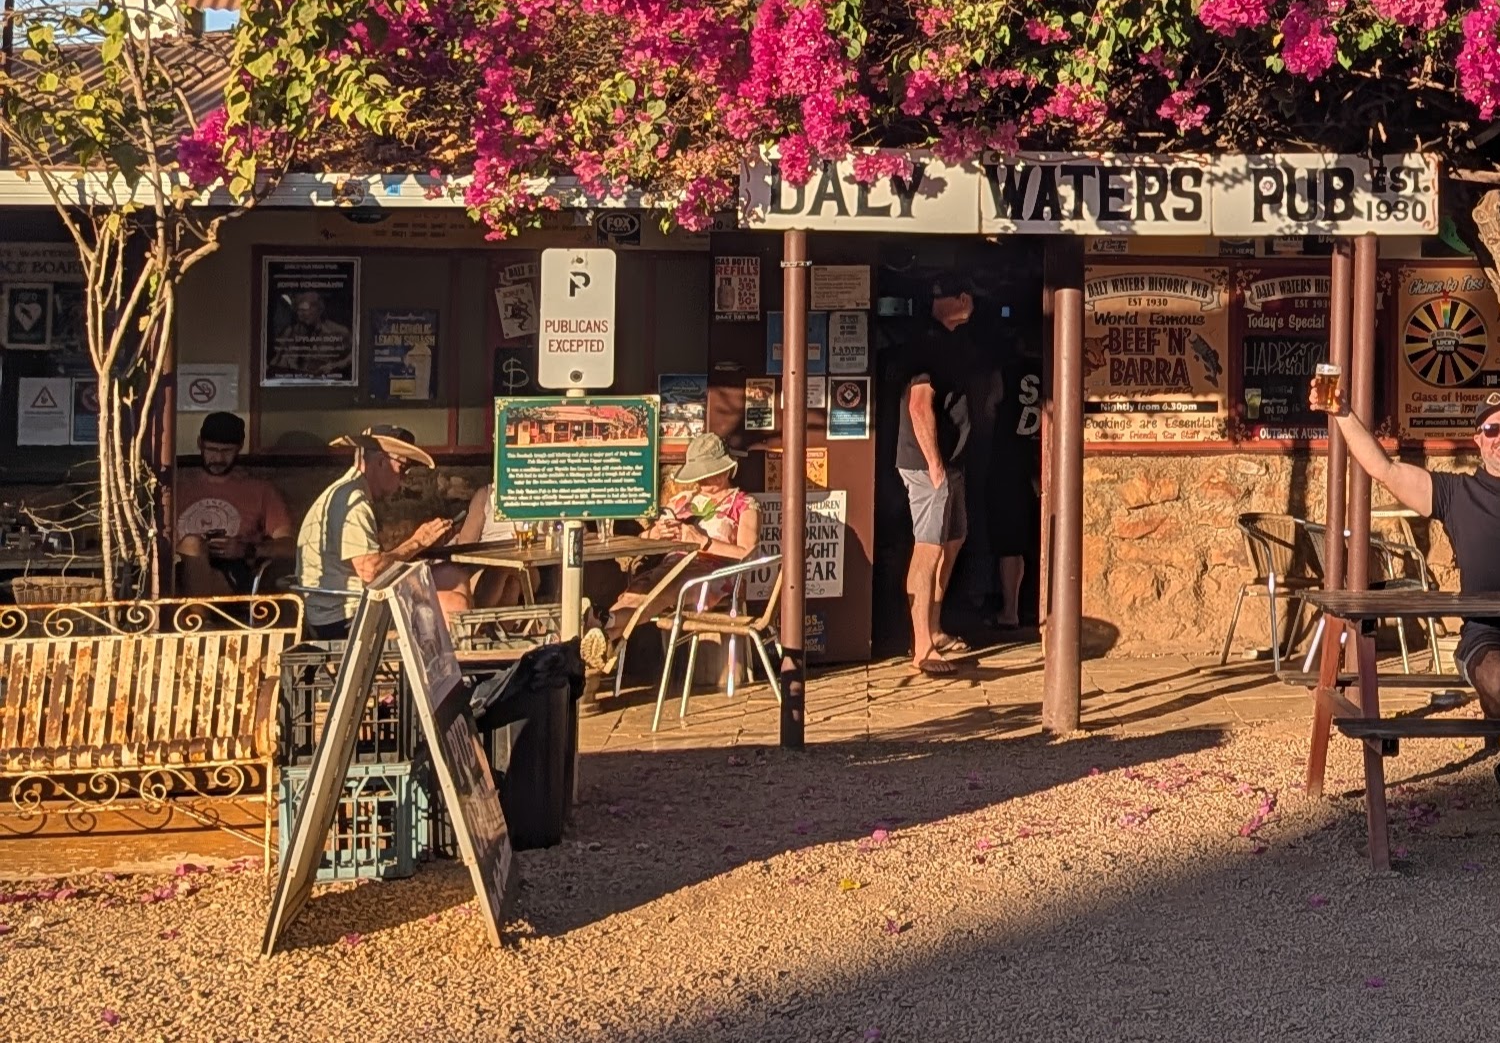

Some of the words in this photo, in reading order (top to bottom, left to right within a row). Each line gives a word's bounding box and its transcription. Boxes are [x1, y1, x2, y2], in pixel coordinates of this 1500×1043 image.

[1371, 166, 1431, 194] EST.
[768, 158, 926, 219] DALY
[984, 164, 1204, 222] WATERS
[1252, 166, 1355, 222] PUB
[1366, 200, 1427, 223] 1930
[715, 266, 759, 275] REFILLS
[1087, 280, 1109, 298] DALY
[1112, 277, 1145, 293] WATERS
[1149, 276, 1188, 293] HISTORIC
[1190, 284, 1209, 299] PUB
[1255, 282, 1276, 299] DALY
[1279, 279, 1312, 295] WATERS
[1408, 278, 1442, 296] Chance
[1460, 274, 1487, 293] Toss
[1128, 298, 1142, 307] EST
[1146, 298, 1168, 307] 1930
[1094, 311, 1139, 326] World
[1149, 312, 1206, 326] Famous
[1247, 313, 1285, 332] Today's
[1288, 313, 1326, 332] Special
[545, 319, 609, 334] PUBLICANS
[548, 339, 605, 353] EXCEPTED
[1108, 327, 1161, 356] BEEF
[1109, 357, 1191, 387] BARRA
[1411, 391, 1438, 402] Glass
[1441, 391, 1451, 402] of
[1455, 391, 1486, 402] House
[1100, 402, 1135, 413] Nightly
[1137, 403, 1160, 411] from
[1405, 403, 1423, 414] Bar
[1139, 419, 1158, 429] are
[1165, 416, 1216, 429] Essential
[1129, 431, 1158, 442] Friendly
[1162, 431, 1177, 440] Bar
[1259, 427, 1299, 440] OUTBACK
